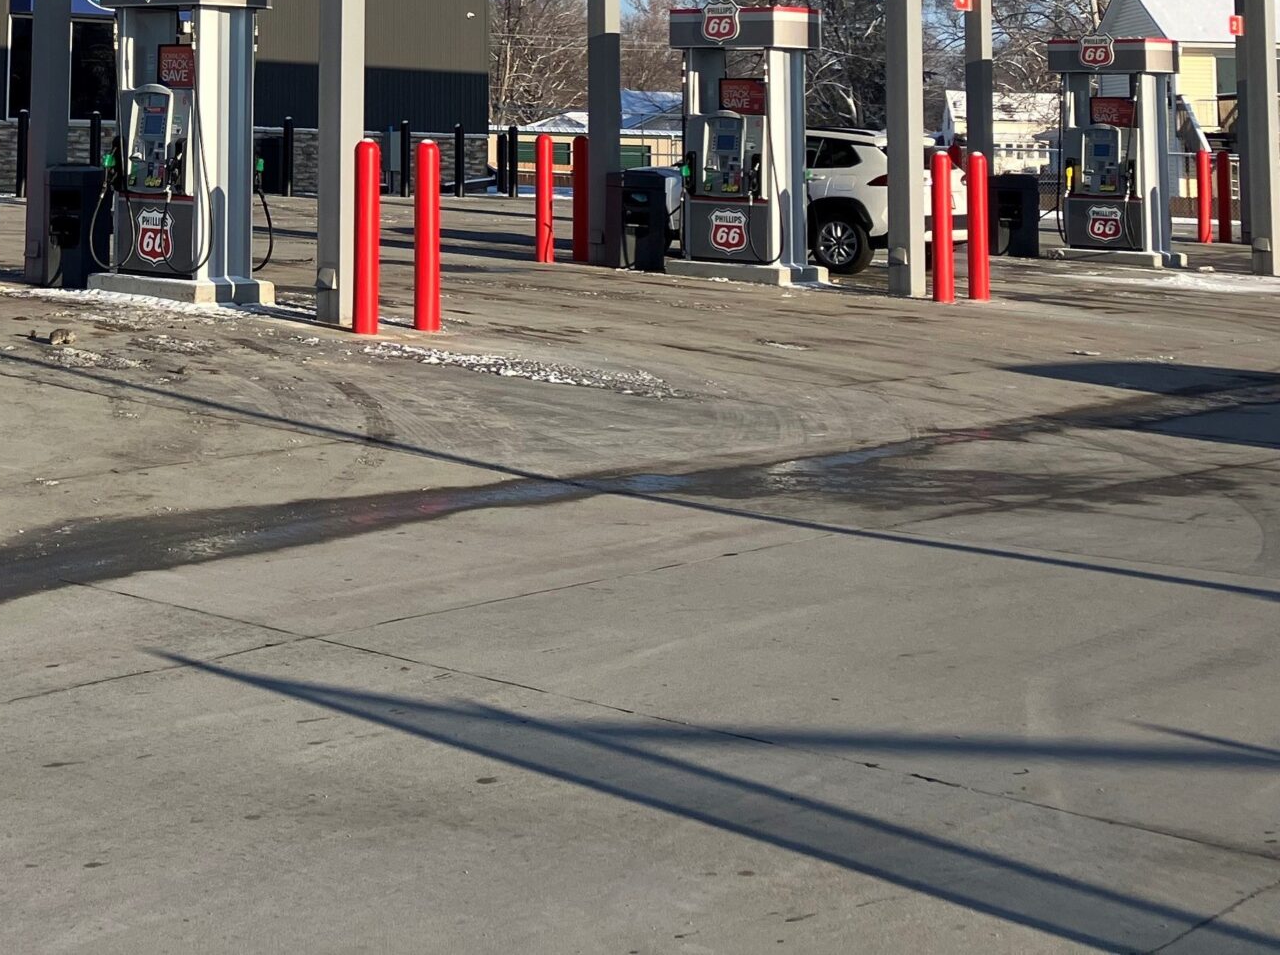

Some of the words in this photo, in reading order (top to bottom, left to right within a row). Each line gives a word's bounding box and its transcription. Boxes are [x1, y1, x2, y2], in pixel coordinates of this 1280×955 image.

[708, 18, 731, 34] 66
[1085, 47, 1107, 61] 66
[162, 59, 188, 69] STACK
[162, 70, 189, 82] SAVE
[723, 98, 750, 108] SAVE
[1094, 114, 1119, 123] SAVE
[142, 216, 168, 227] PHILLIS
[715, 215, 743, 224] PHILLIPS
[1094, 220, 1117, 234] 66
[716, 227, 740, 244] 66
